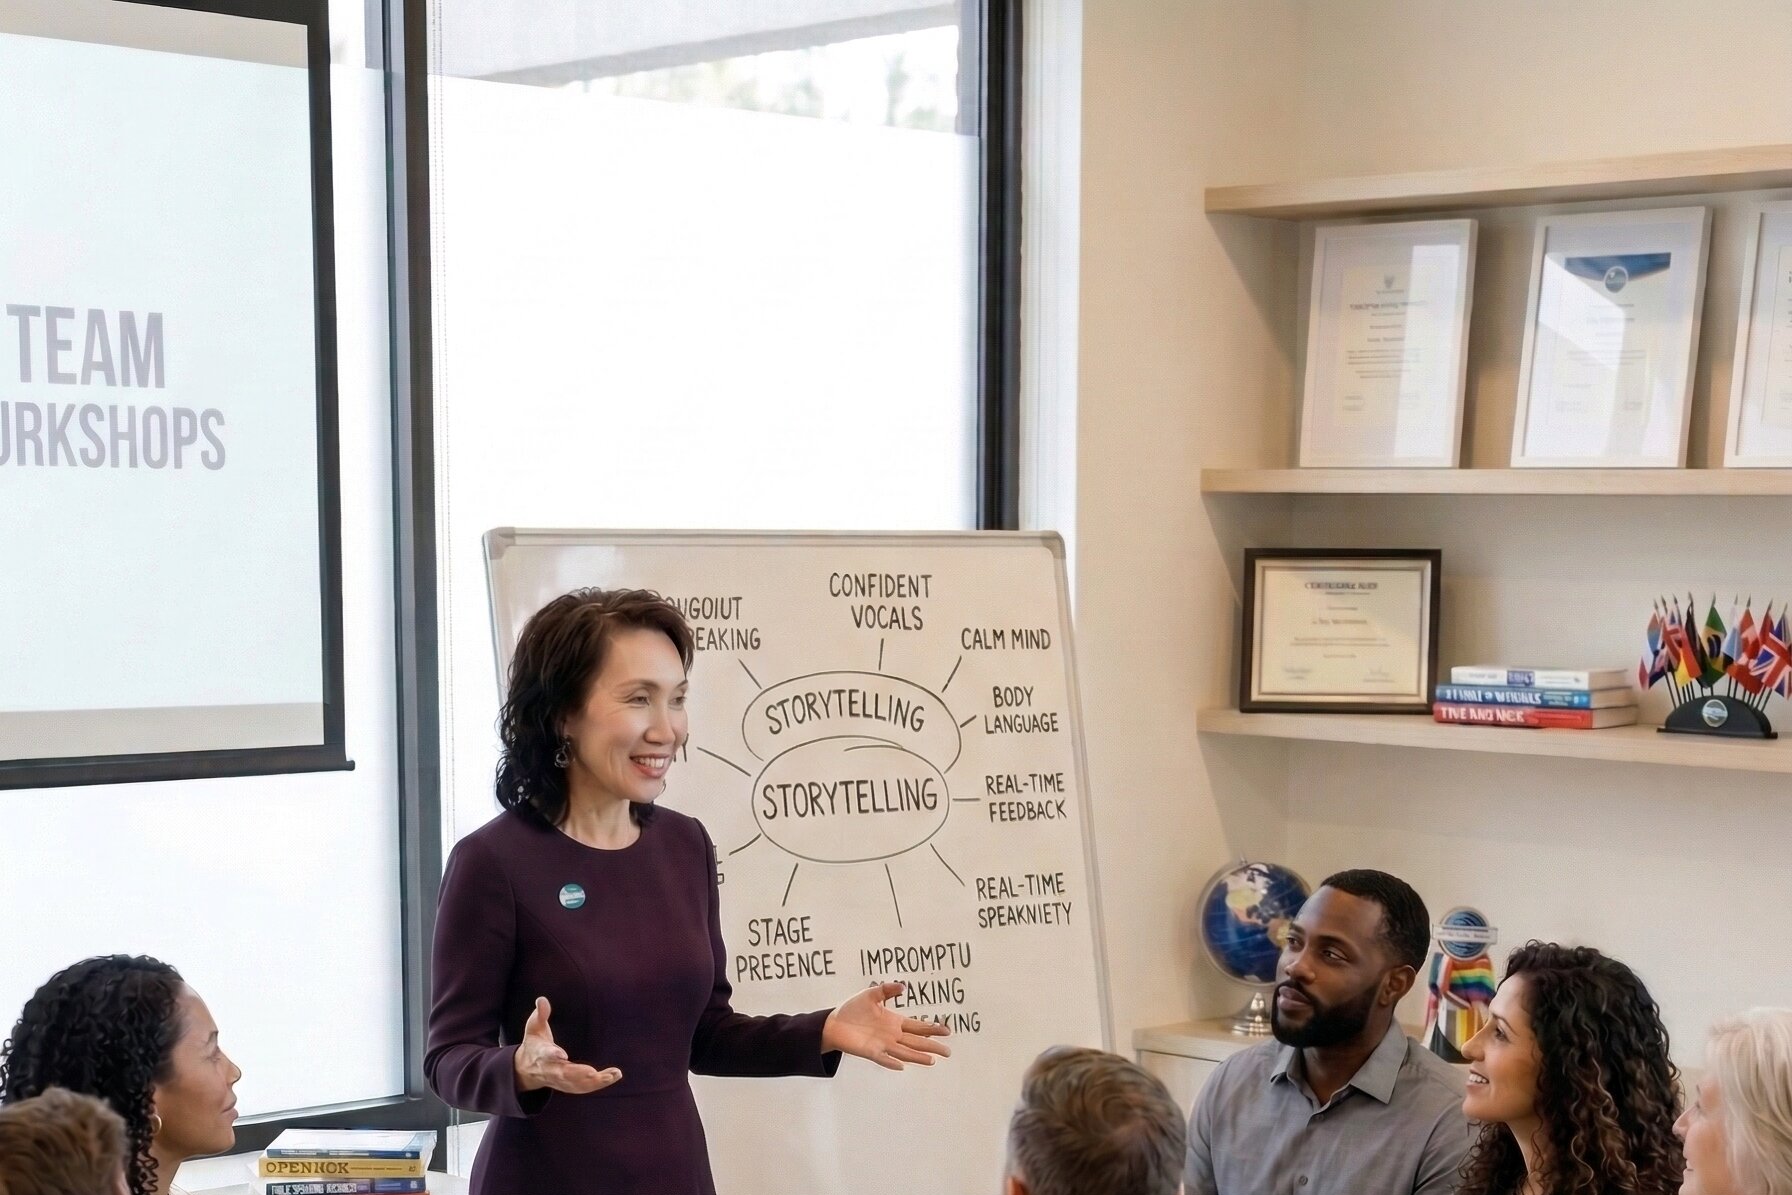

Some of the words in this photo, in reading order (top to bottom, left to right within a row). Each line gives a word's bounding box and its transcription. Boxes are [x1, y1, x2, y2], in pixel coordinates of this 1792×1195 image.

[6, 303, 165, 389] TEAM
[829, 572, 932, 598] CONFIDENT
[850, 604, 924, 631] VOCALS
[961, 627, 1005, 650] CALM
[1011, 628, 1051, 650] MIND
[992, 685, 1034, 708] BODY
[765, 689, 924, 735] STORYTELLING
[984, 712, 1059, 735] LANGUAGE
[985, 772, 1065, 796] REAL-TIME
[763, 777, 938, 820] STORYTELLING
[989, 799, 1067, 823] FEEDBACK
[976, 872, 1065, 902] REAL-TIME
[978, 901, 1072, 929] SPEAKNIETY
[748, 916, 813, 947] STAGE
[735, 949, 836, 983] PRESENCE
[860, 941, 971, 976] IMPROMPTU
